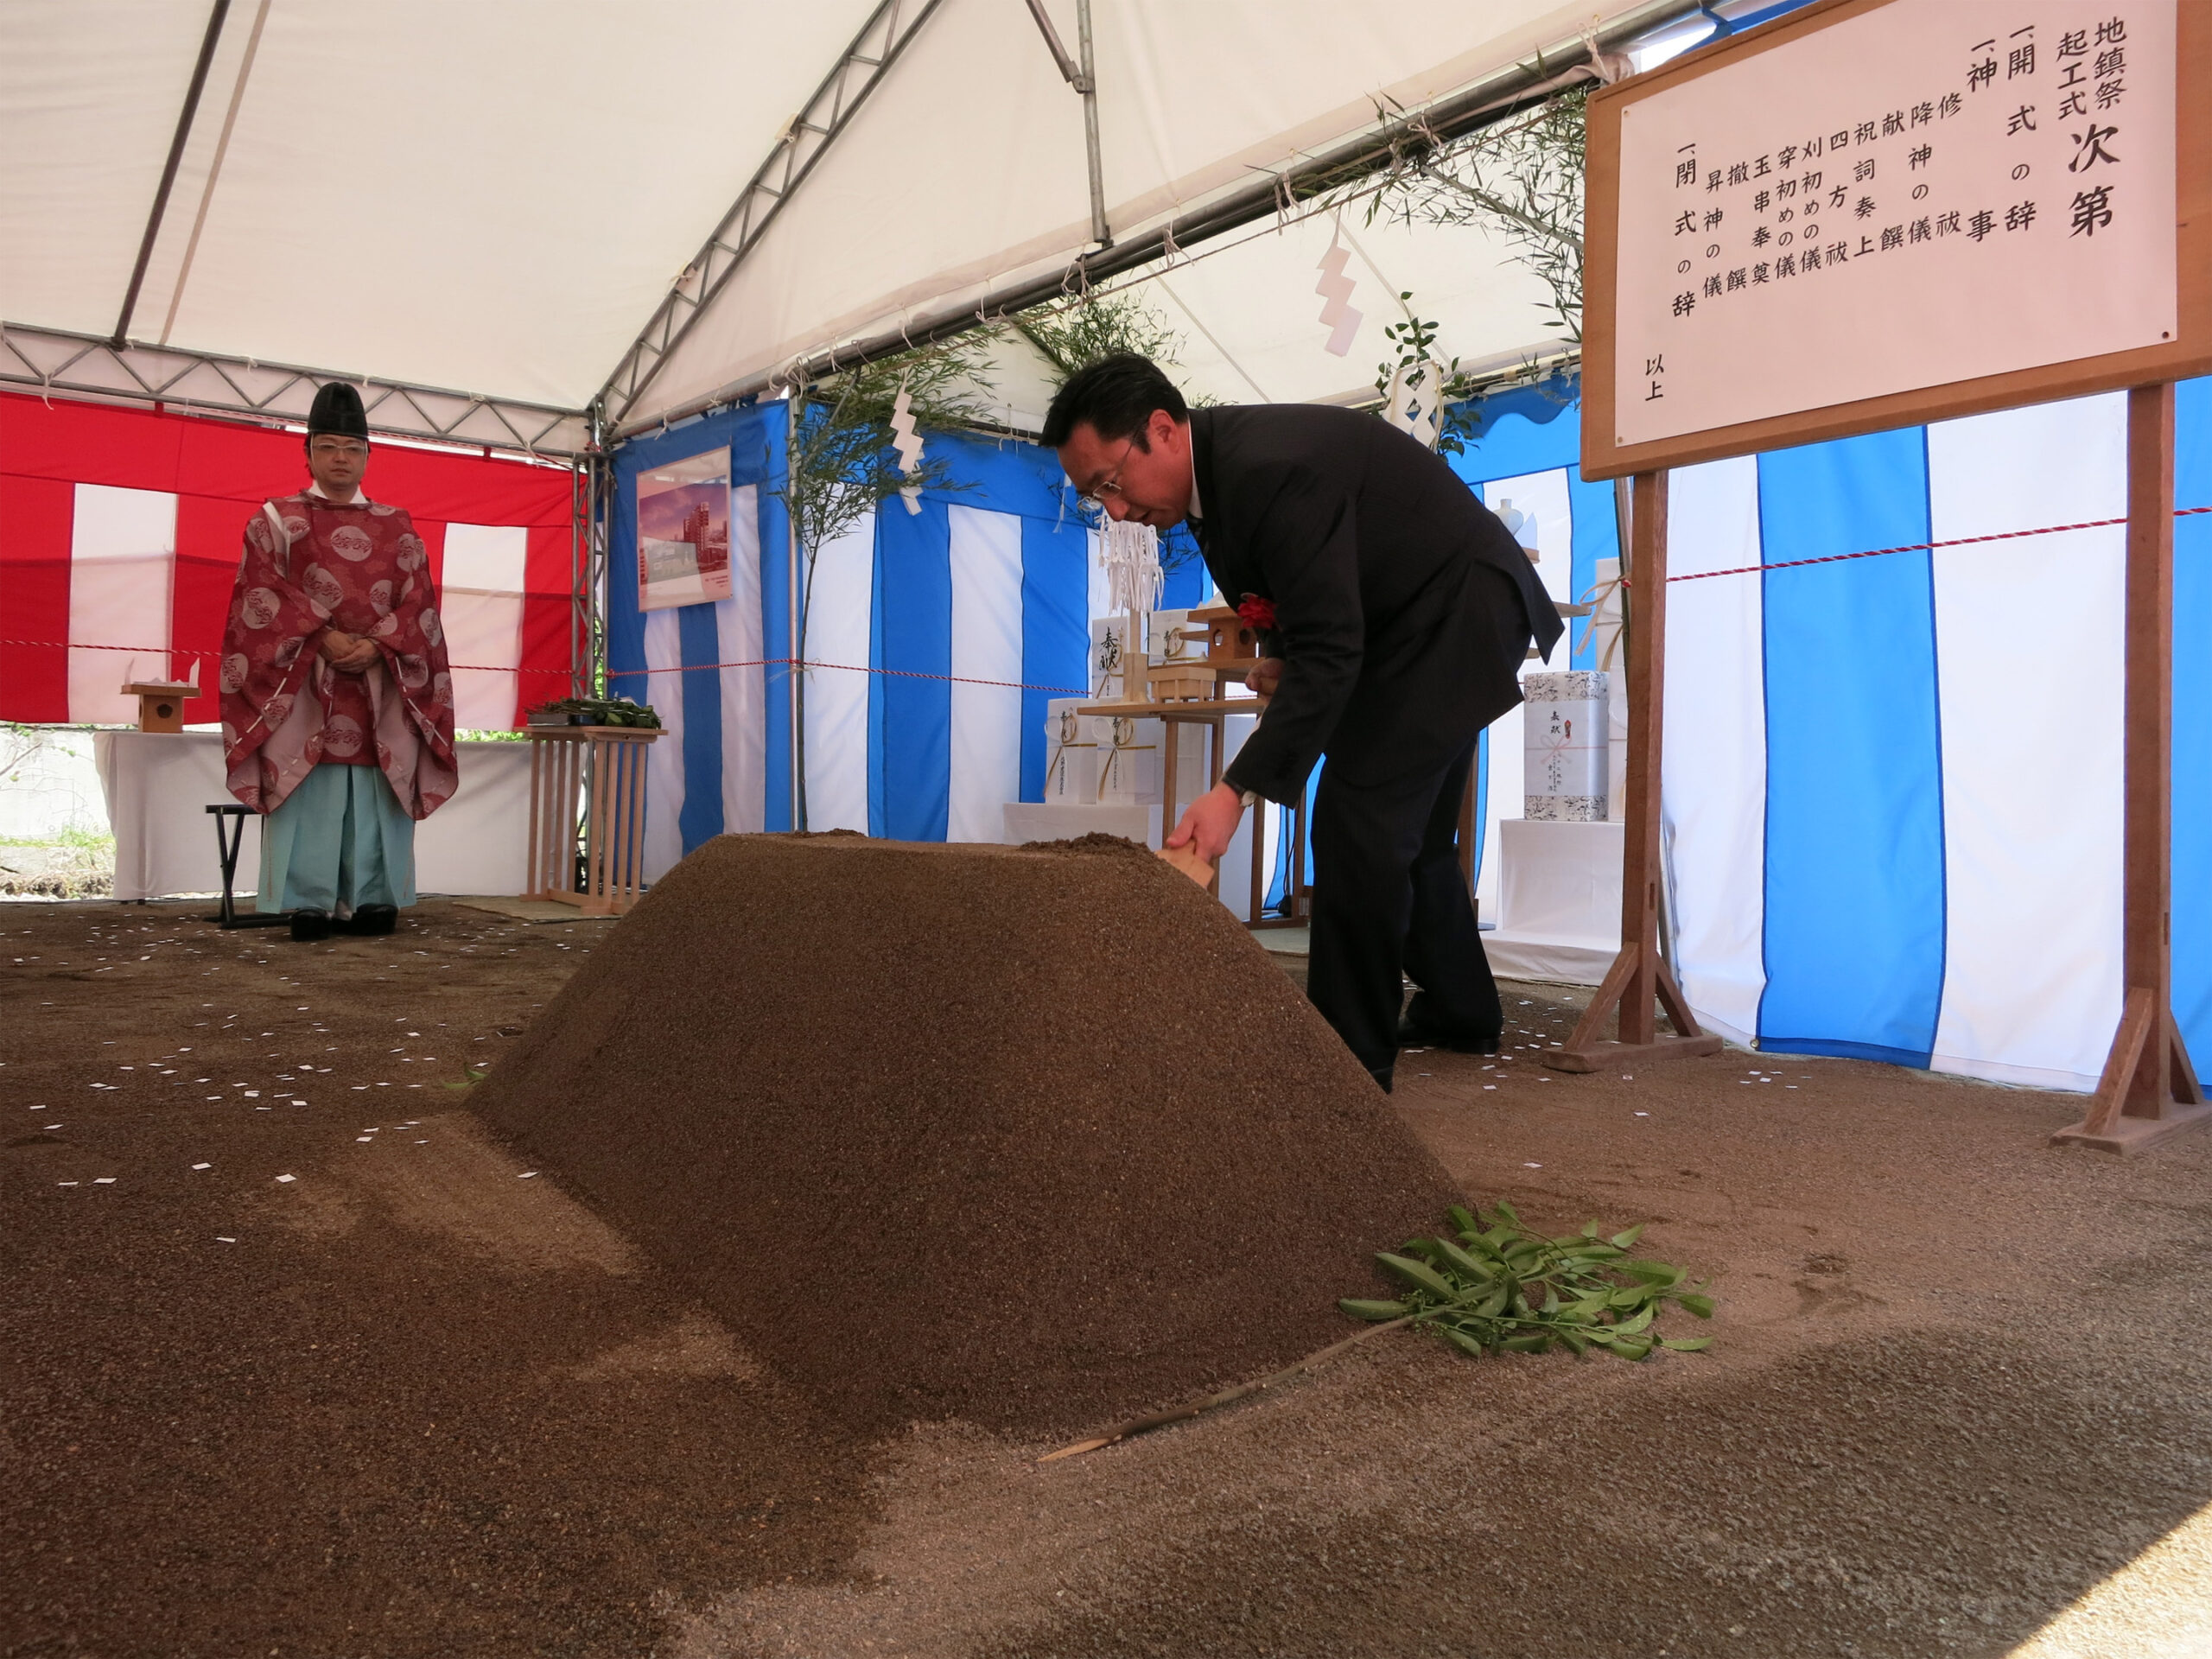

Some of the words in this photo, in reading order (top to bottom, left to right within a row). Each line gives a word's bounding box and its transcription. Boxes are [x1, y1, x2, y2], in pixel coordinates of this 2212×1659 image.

[2056, 29, 2089, 120] 起工式
[2093, 16, 2126, 110] 地鎮祭
[1702, 169, 1724, 299] 昇神の儀
[1751, 155, 1772, 287] 玉串奉奠
[1774, 145, 1797, 280] 穿初めの儀
[1799, 137, 1822, 273] 刈初めの儀
[1853, 121, 1878, 257] 祝詞奏上
[1907, 101, 1934, 245] 降神の儀
[2068, 124, 2120, 238] 次第
[1644, 353, 1665, 402] 以上
